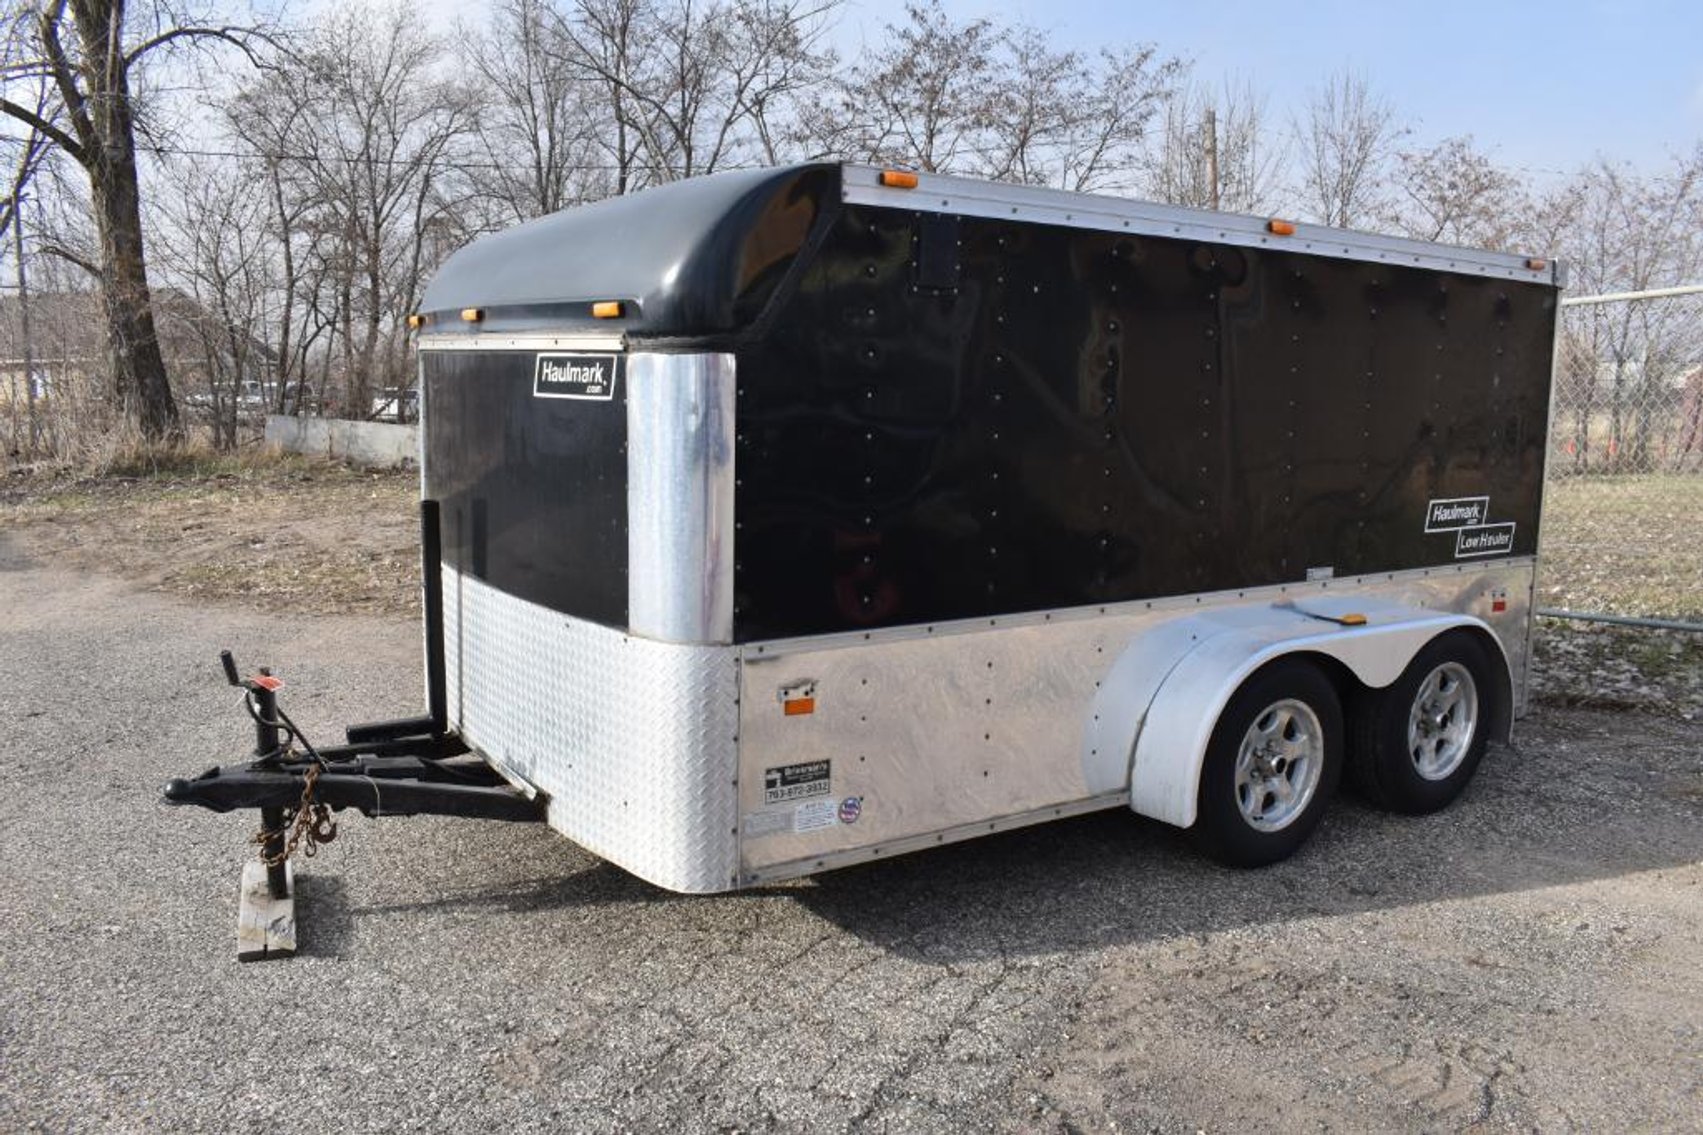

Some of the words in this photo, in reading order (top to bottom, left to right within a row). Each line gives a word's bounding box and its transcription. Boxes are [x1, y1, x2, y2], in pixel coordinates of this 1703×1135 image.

[542, 361, 604, 384] Haulmark
[1432, 503, 1480, 522] Haulmark
[1460, 534, 1480, 549] Low
[1479, 532, 1510, 546] Hauler
